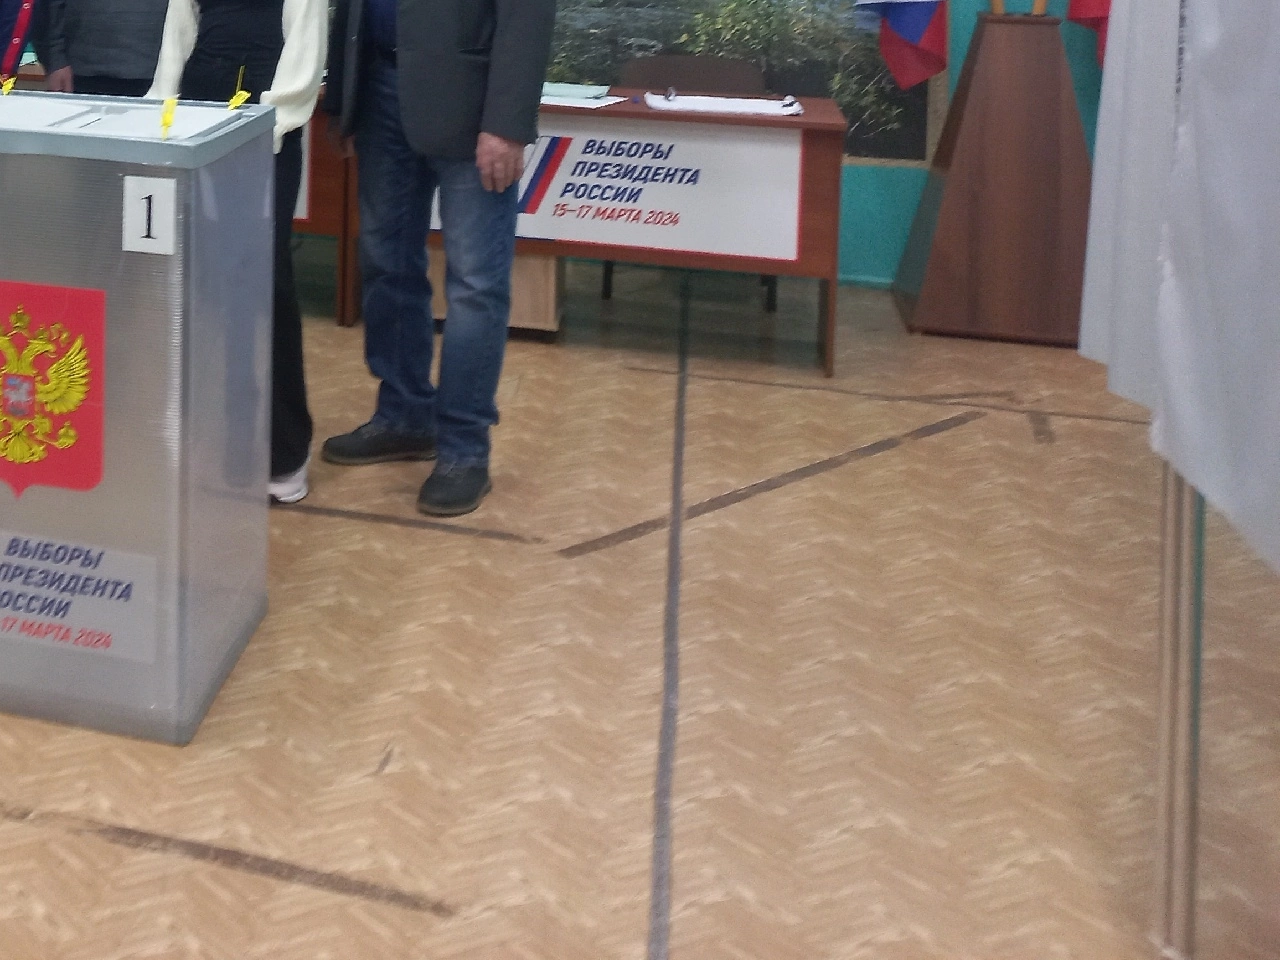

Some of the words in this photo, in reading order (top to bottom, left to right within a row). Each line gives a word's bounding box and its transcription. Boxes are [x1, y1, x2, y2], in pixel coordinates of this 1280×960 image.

[581, 139, 675, 161] ВЫБОРЫ
[570, 160, 702, 186] ПРЕЗИДЕНТА
[559, 182, 644, 204] РОССИИ
[140, 194, 157, 239] 1
[591, 206, 642, 223] МАРТА
[643, 210, 681, 227] 2024
[3, 537, 105, 570] ВЫБОРЫ
[19, 619, 72, 643] МАРТА
[72, 628, 113, 651] 2024
